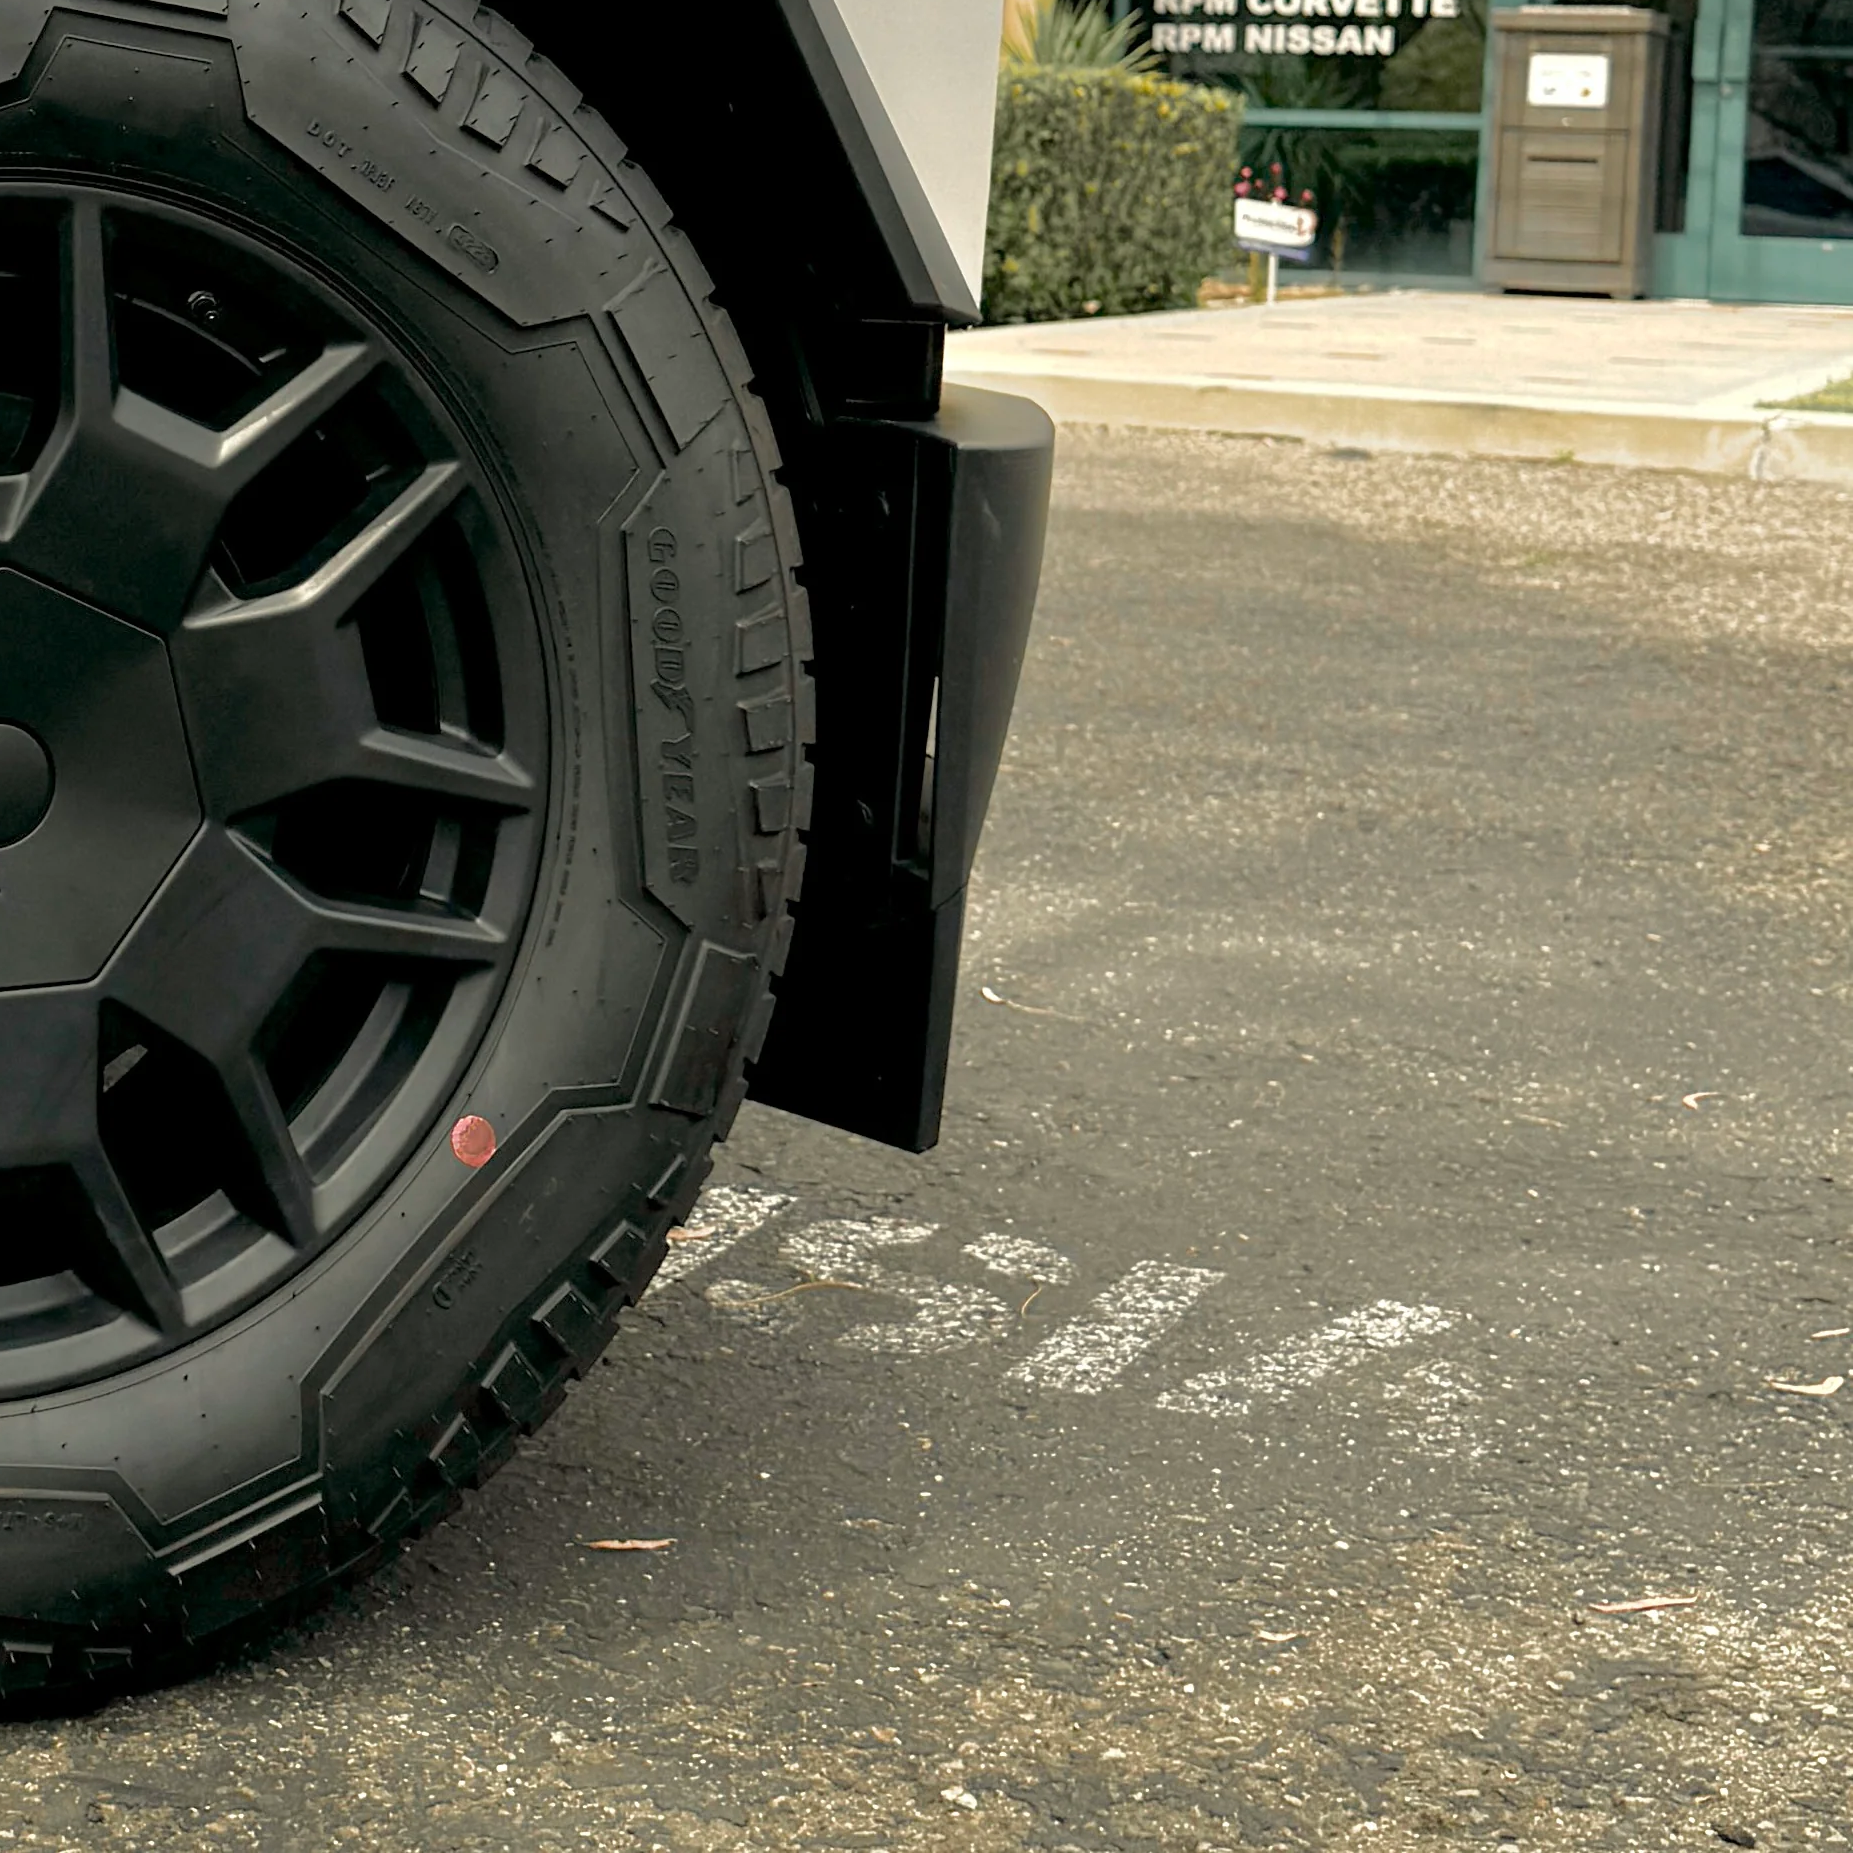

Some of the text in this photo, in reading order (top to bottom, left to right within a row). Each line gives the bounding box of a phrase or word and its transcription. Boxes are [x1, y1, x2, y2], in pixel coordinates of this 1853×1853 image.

[1151, 21, 1395, 57] RPM NISSAN
[647, 525, 700, 887] GOODYEAR
